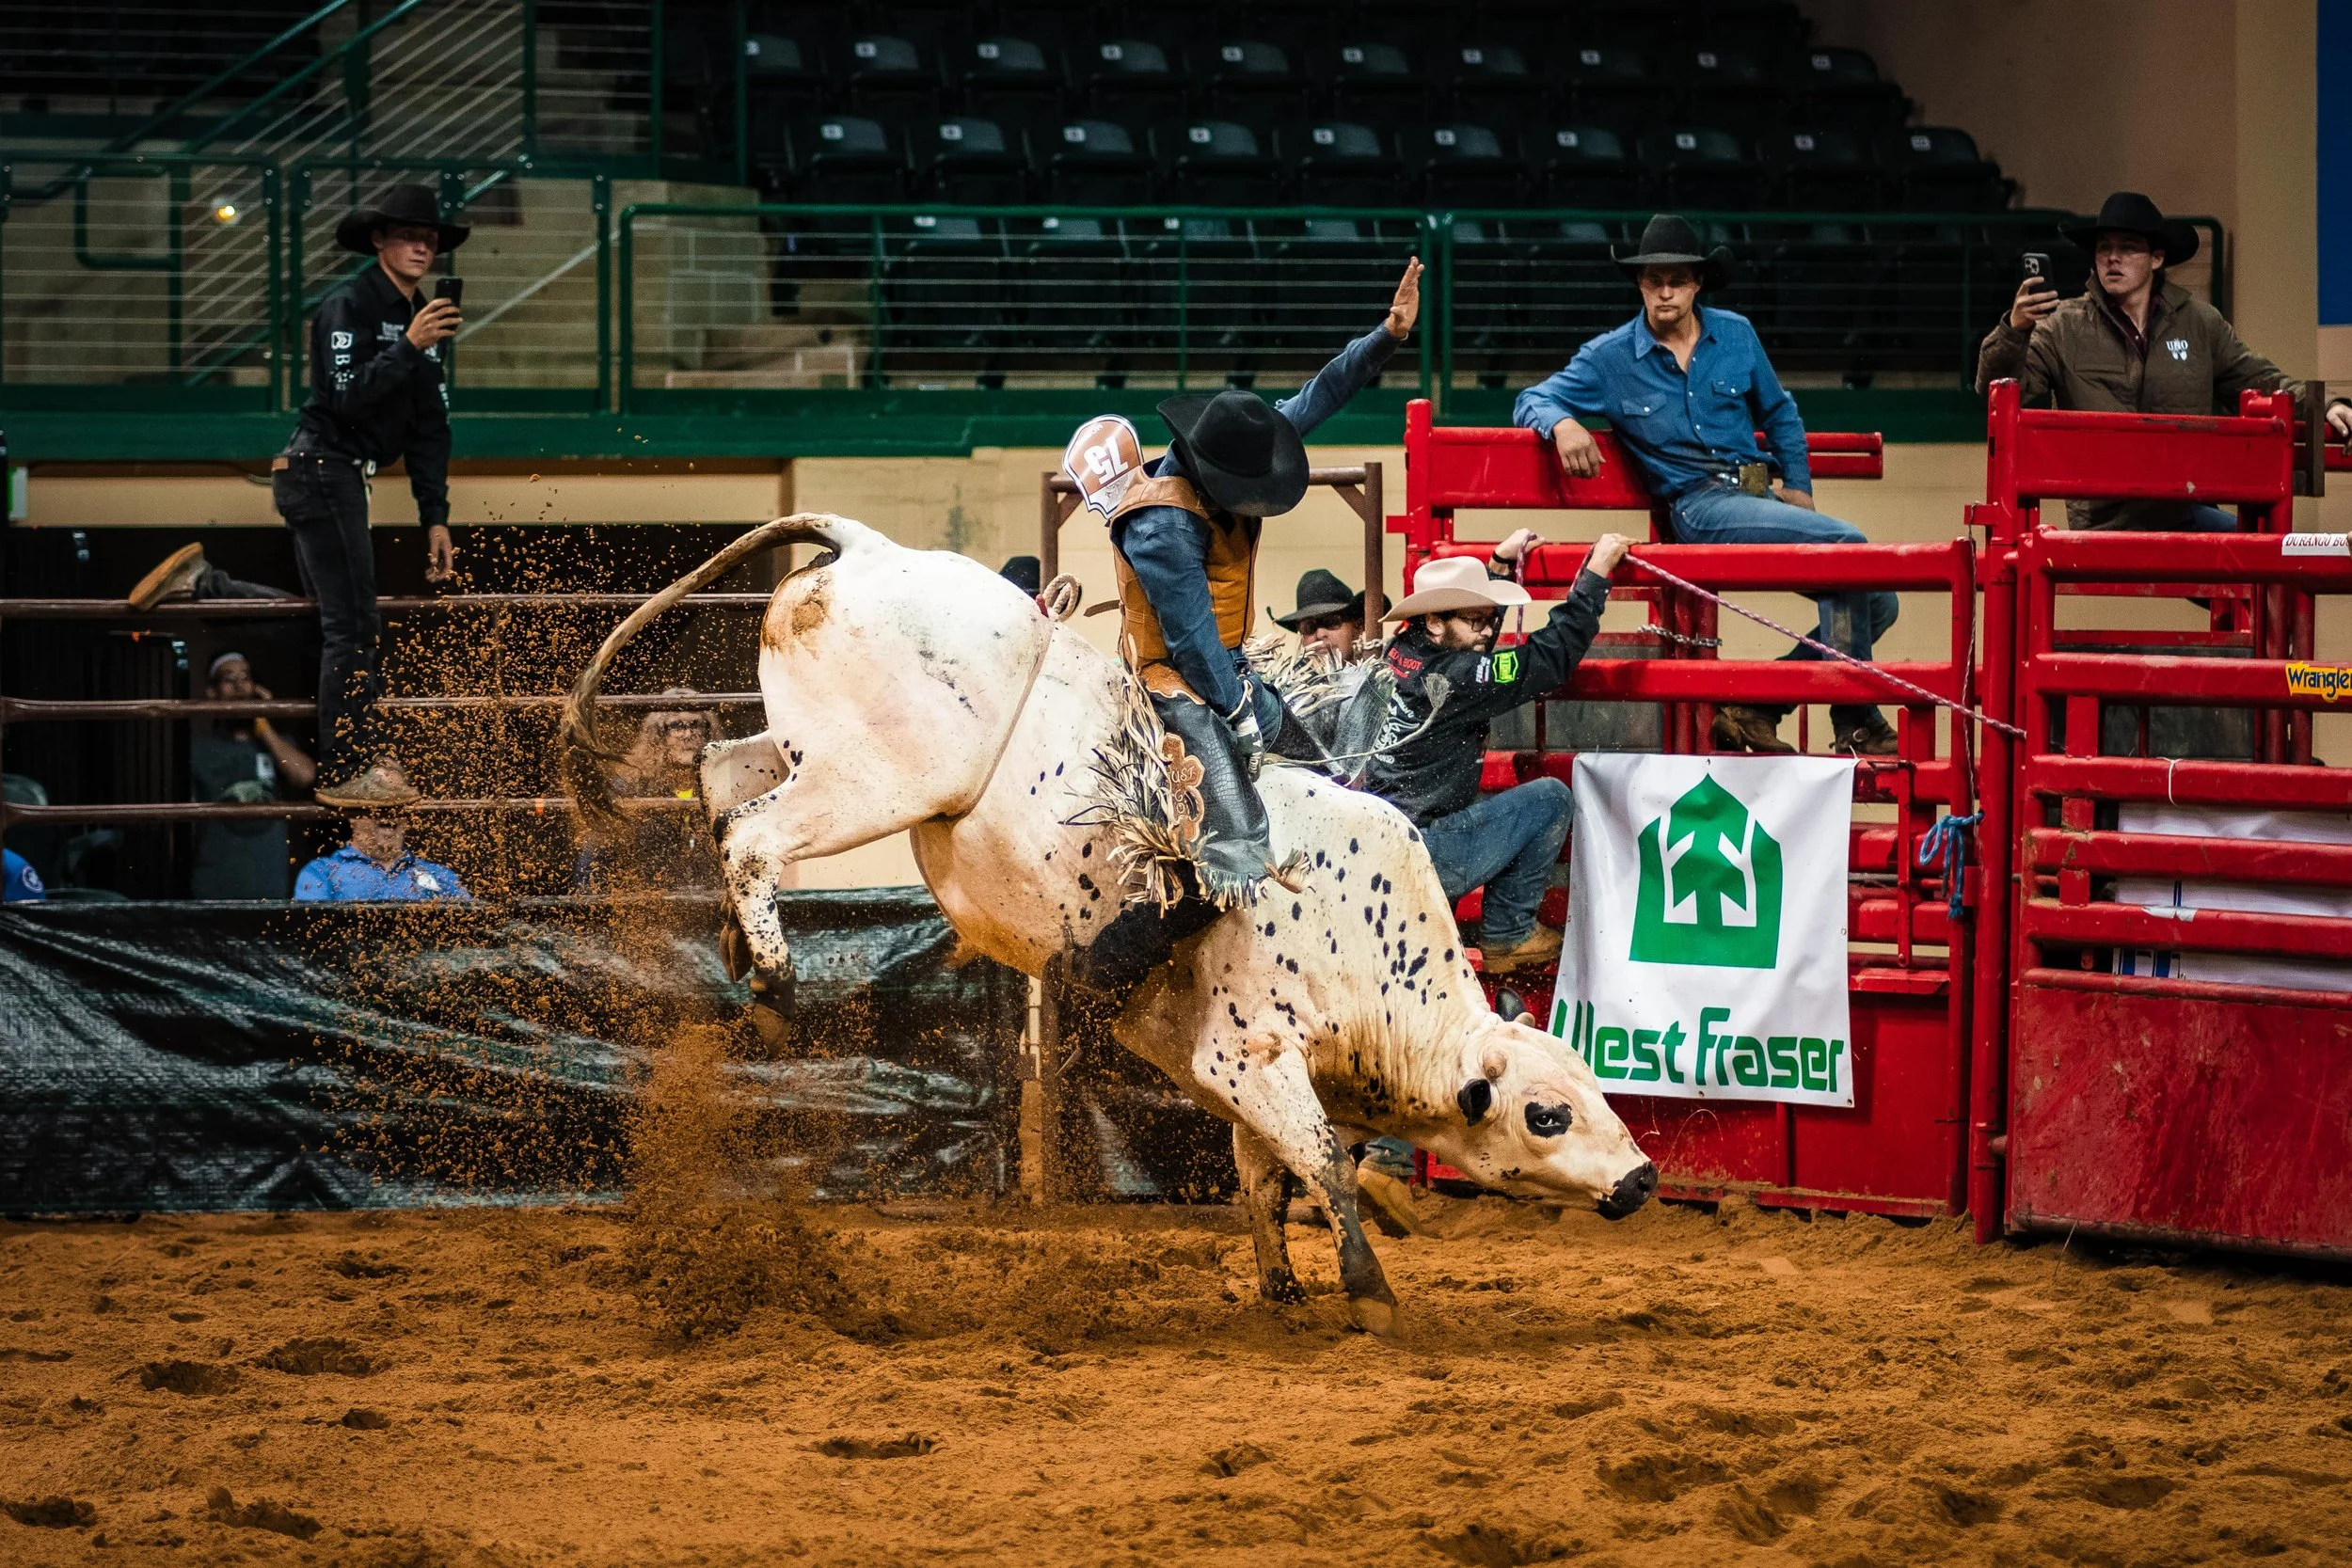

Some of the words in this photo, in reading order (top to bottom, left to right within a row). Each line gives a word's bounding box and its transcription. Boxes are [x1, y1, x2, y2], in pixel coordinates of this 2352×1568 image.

[1084, 436, 1128, 484] 75
[2286, 536, 2331, 546] DURANGO
[1170, 766, 1194, 784] UST
[1553, 999, 1686, 1084] West
[1694, 1006, 1844, 1093] Fraser
